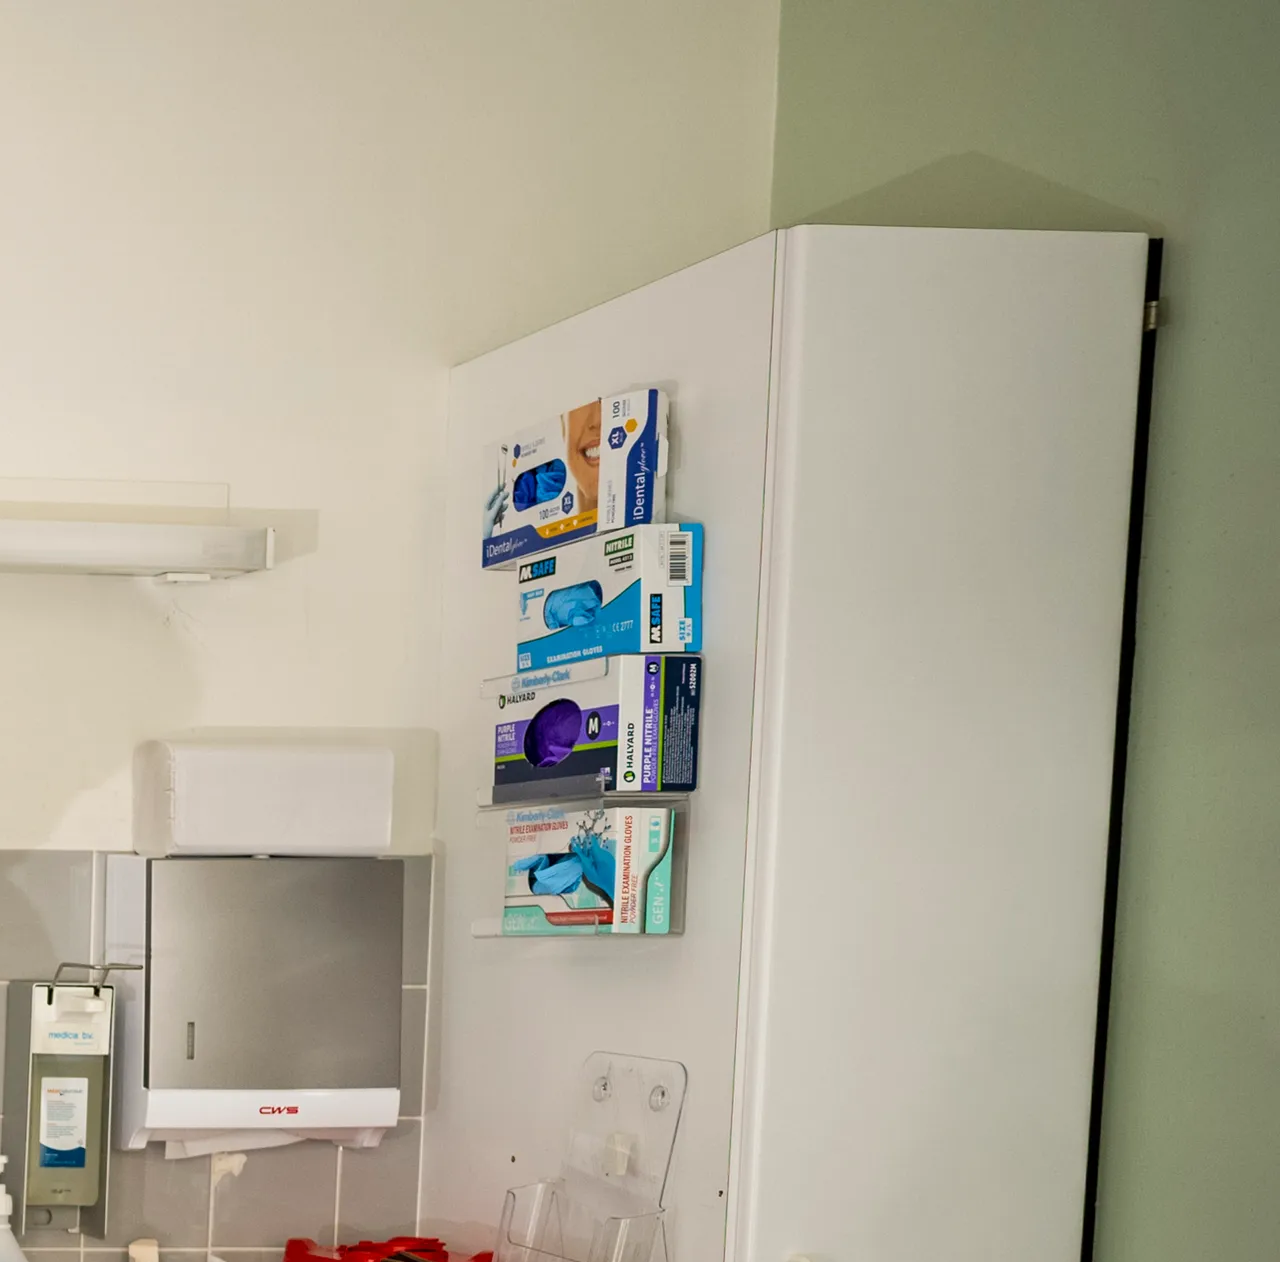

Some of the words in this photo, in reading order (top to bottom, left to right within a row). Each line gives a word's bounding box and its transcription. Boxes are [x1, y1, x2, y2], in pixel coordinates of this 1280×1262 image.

[612, 401, 620, 419] 100
[611, 431, 619, 445] XL
[606, 537, 633, 553] NITRILE
[506, 691, 536, 705] HALYARD
[497, 723, 515, 734] PURPLE
[588, 717, 599, 735] M
[645, 708, 653, 745] NITRILE
[627, 722, 635, 768] HALYARD
[643, 747, 652, 783] PURPLE
[624, 816, 633, 844] GLOVES
[622, 845, 631, 894] EXAMINATION
[621, 896, 630, 924] NITRILE
[259, 1106, 299, 1114] CWS
